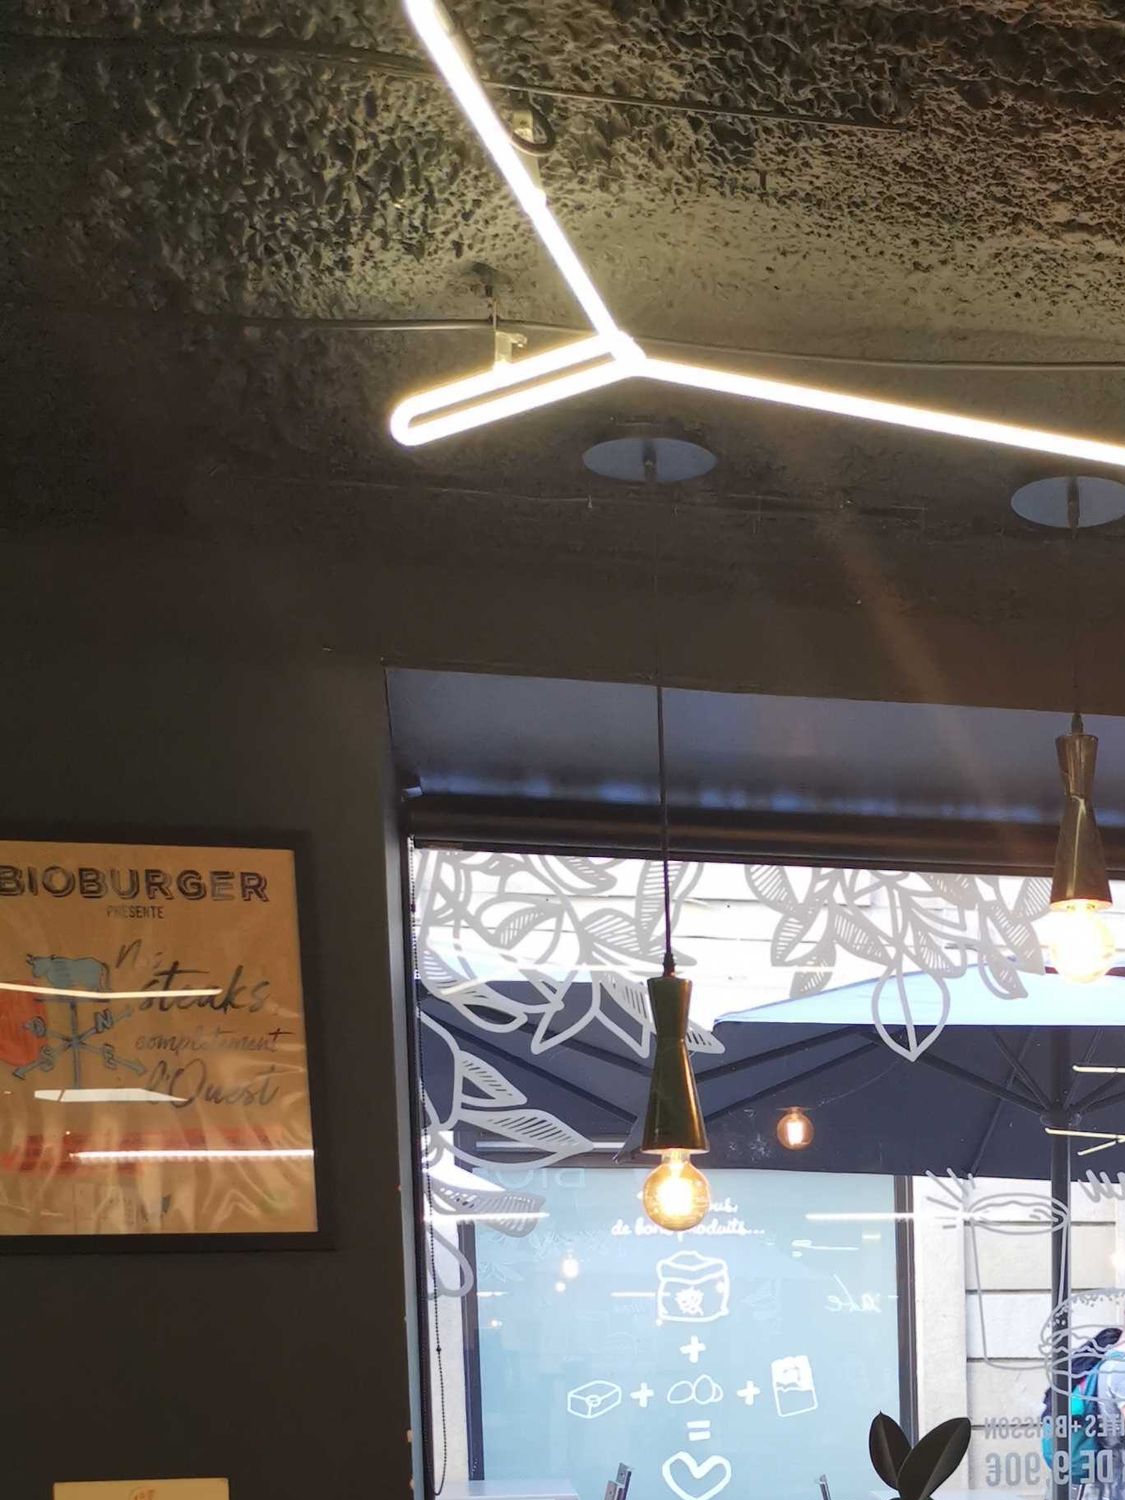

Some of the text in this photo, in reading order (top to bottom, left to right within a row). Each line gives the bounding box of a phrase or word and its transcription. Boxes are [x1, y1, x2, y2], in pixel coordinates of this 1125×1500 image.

[0, 864, 269, 902] BIOBURGER
[139, 961, 271, 1014] steaks
[611, 1219, 632, 1236] de
